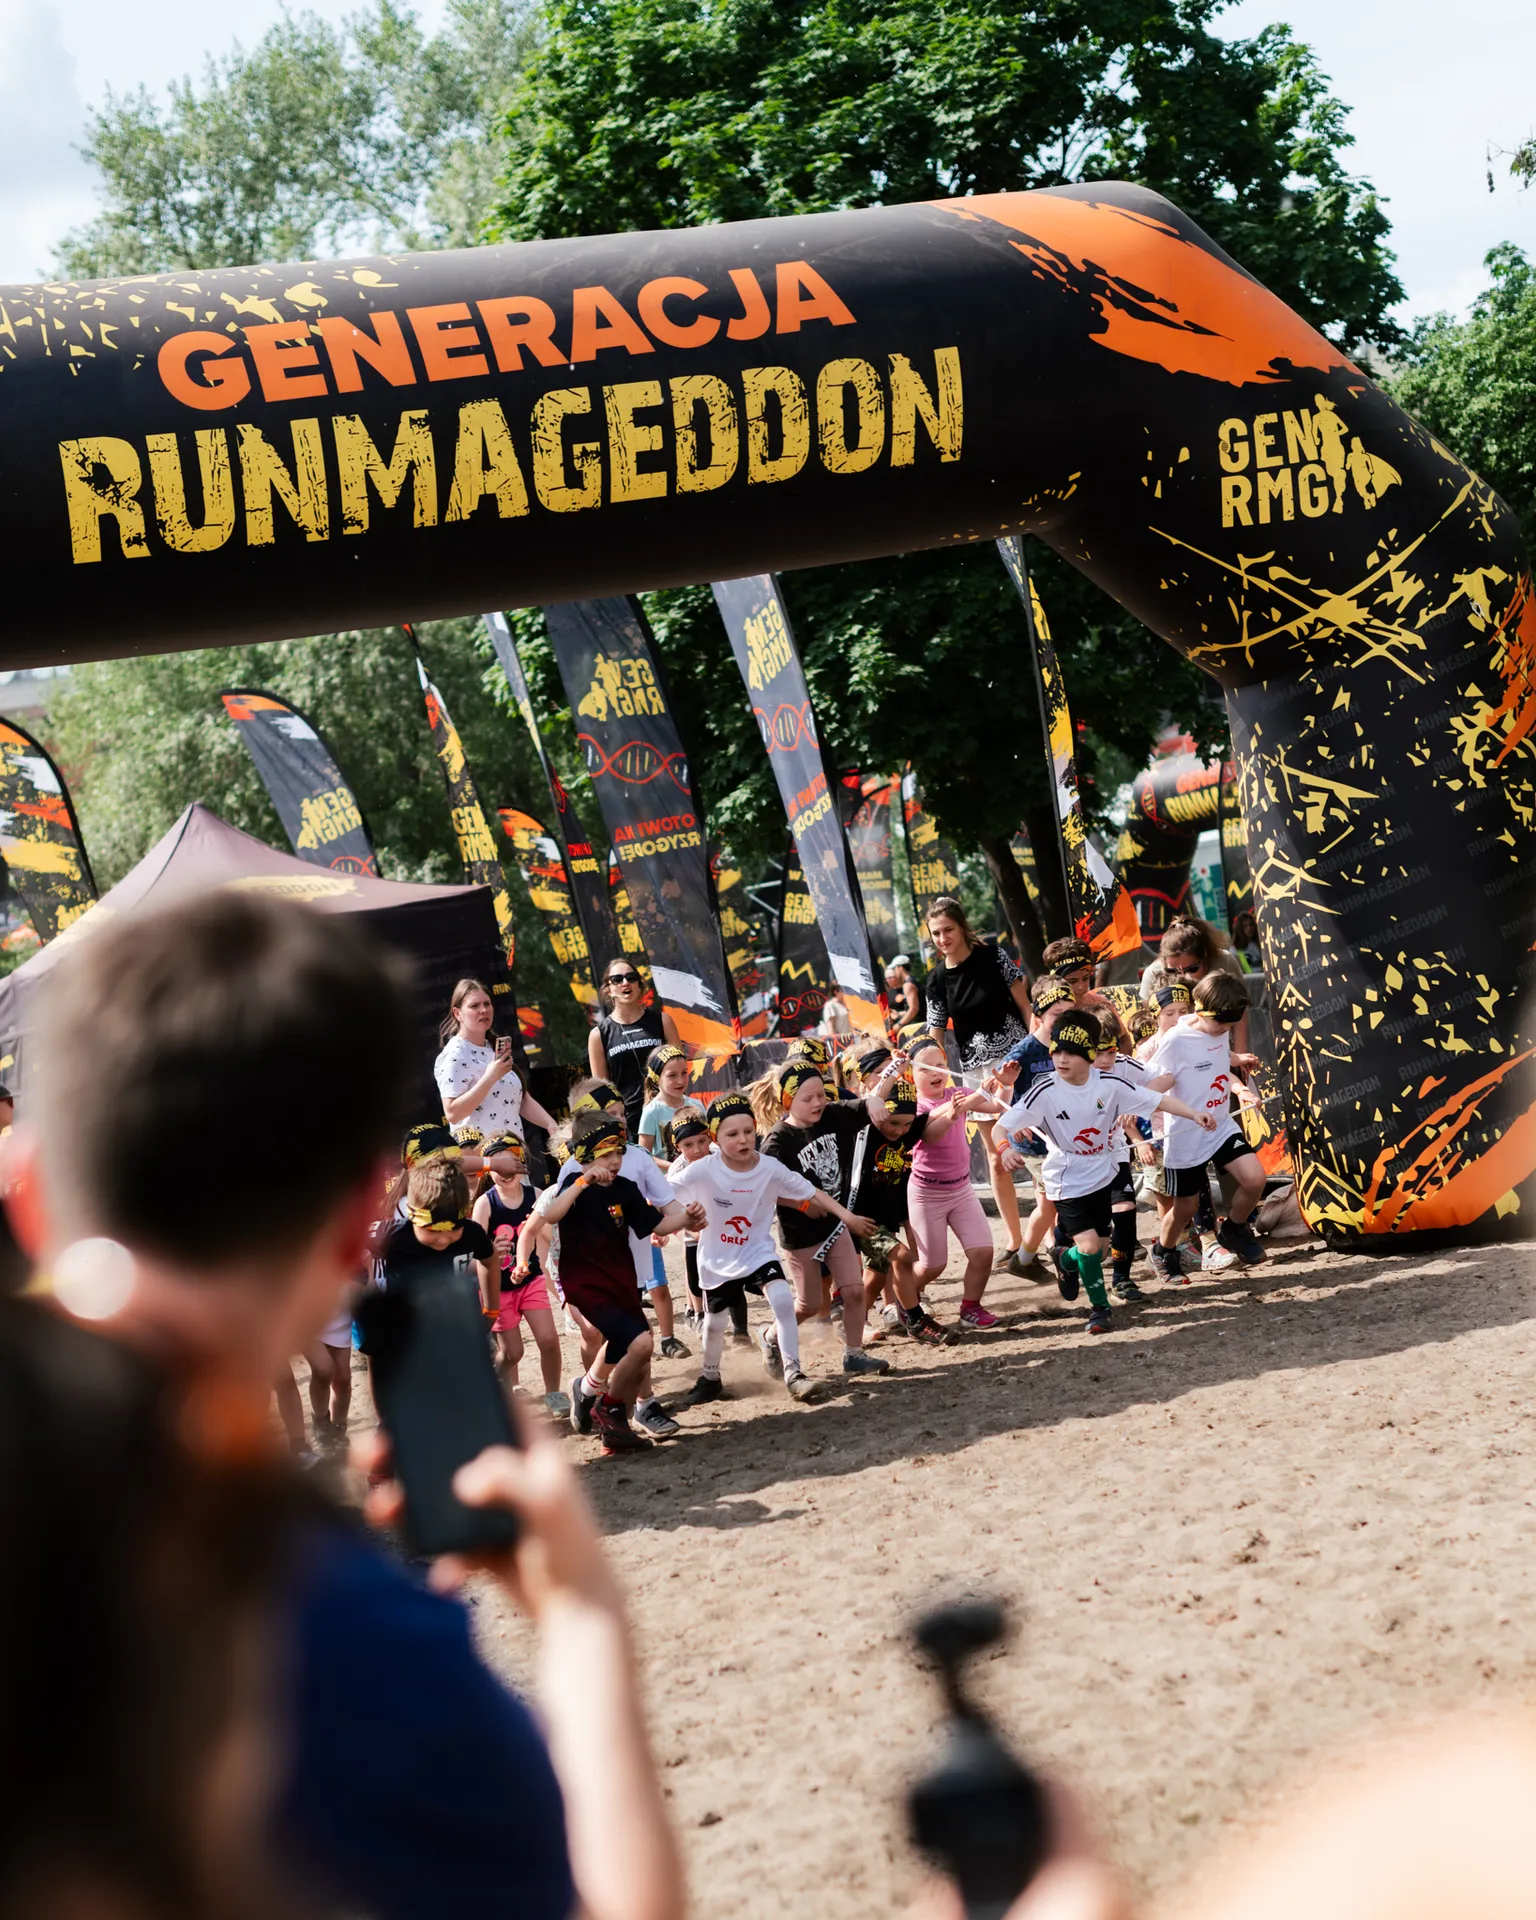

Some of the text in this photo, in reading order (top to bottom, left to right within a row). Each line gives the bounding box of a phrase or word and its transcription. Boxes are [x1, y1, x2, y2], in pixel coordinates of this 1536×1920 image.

[157, 260, 856, 412] GENERACJA
[59, 346, 966, 565] RUNMAGEDDON
[1220, 403, 1319, 475] GEN
[1220, 463, 1331, 528] RMG
[609, 1039, 662, 1058] RUNMAGEDDON
